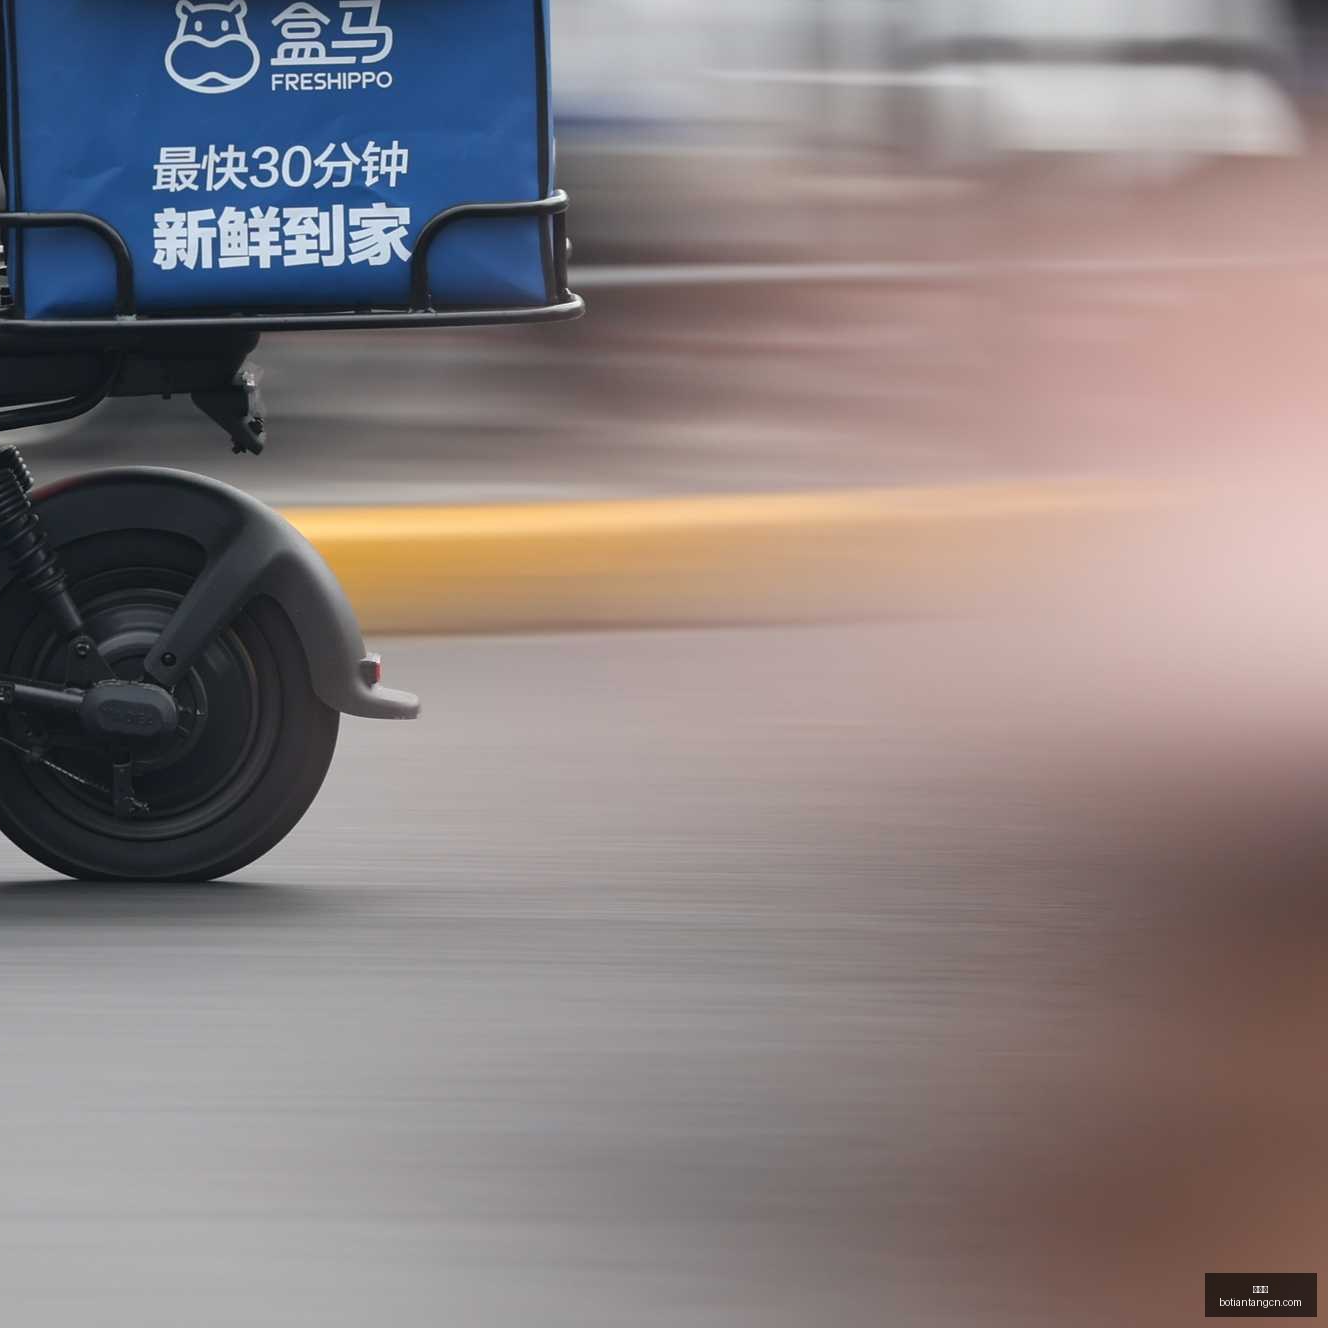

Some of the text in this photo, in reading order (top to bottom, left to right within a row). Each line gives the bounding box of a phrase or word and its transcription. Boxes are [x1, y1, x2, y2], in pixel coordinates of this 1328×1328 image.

[270, 0, 394, 66] 盒马
[271, 71, 393, 91] FRESHIPPO
[152, 140, 409, 193] 最快30分钟
[152, 202, 413, 271] 新鲜到家
